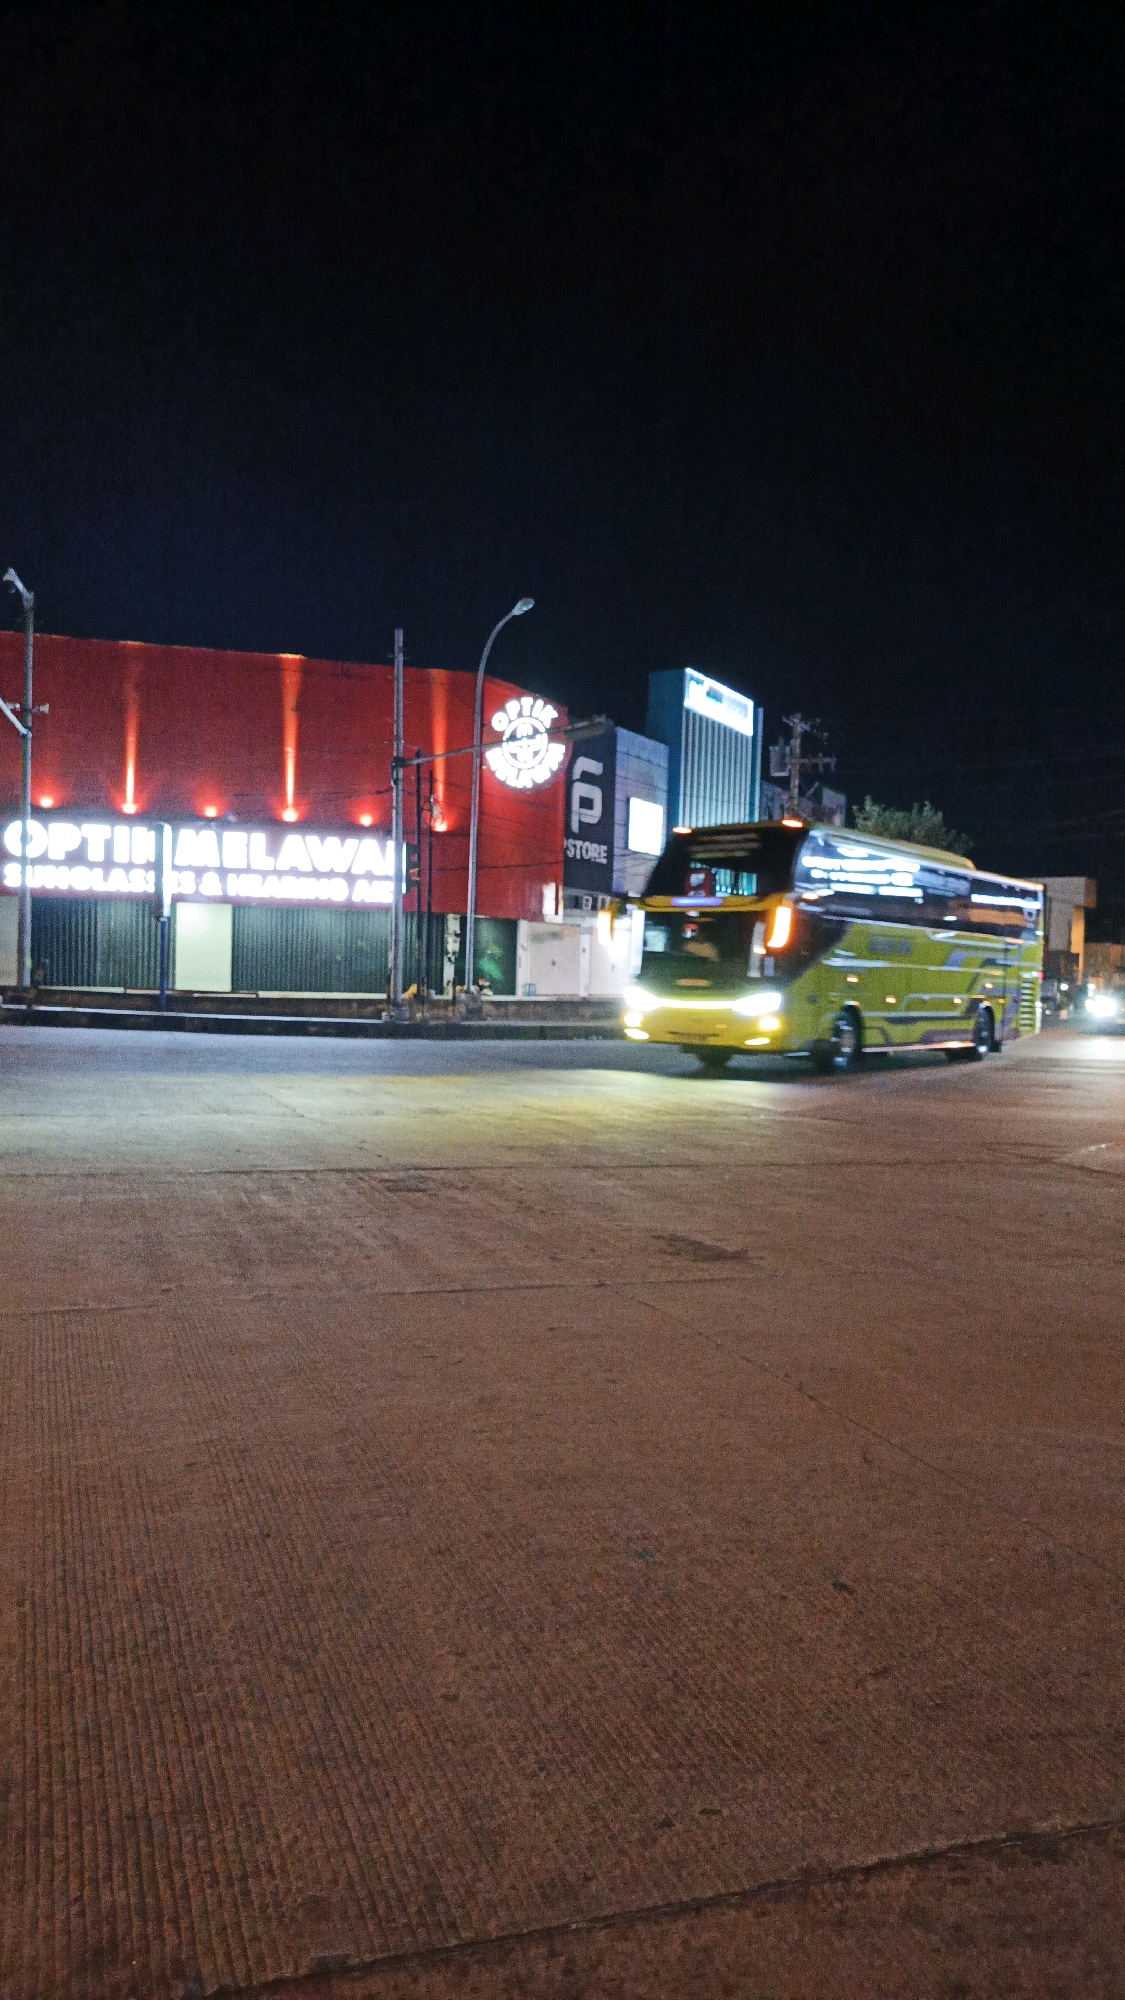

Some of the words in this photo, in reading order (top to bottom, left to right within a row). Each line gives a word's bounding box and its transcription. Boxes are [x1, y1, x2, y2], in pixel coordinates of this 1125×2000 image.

[491, 696, 559, 732] OPTIK
[563, 837, 608, 865] STORE
[198, 872, 223, 896] &
[350, 878, 396, 904] AID
